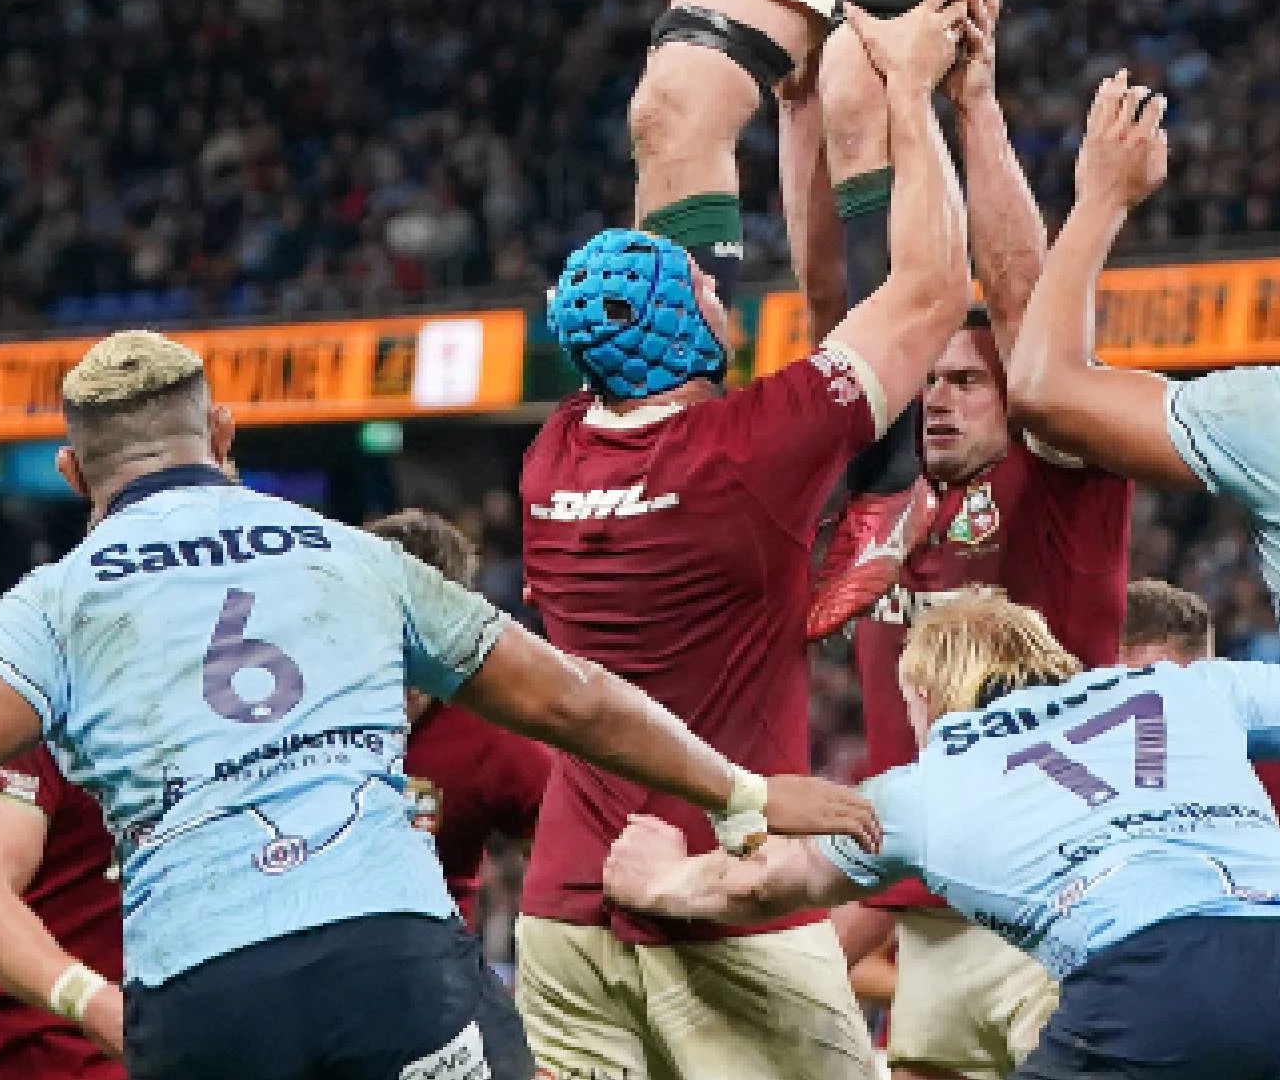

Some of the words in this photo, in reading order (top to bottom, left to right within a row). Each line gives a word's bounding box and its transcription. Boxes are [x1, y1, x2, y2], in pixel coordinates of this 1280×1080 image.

[90, 525, 332, 582] Santos
[202, 587, 304, 724] 6
[1002, 689, 1168, 808] 17
